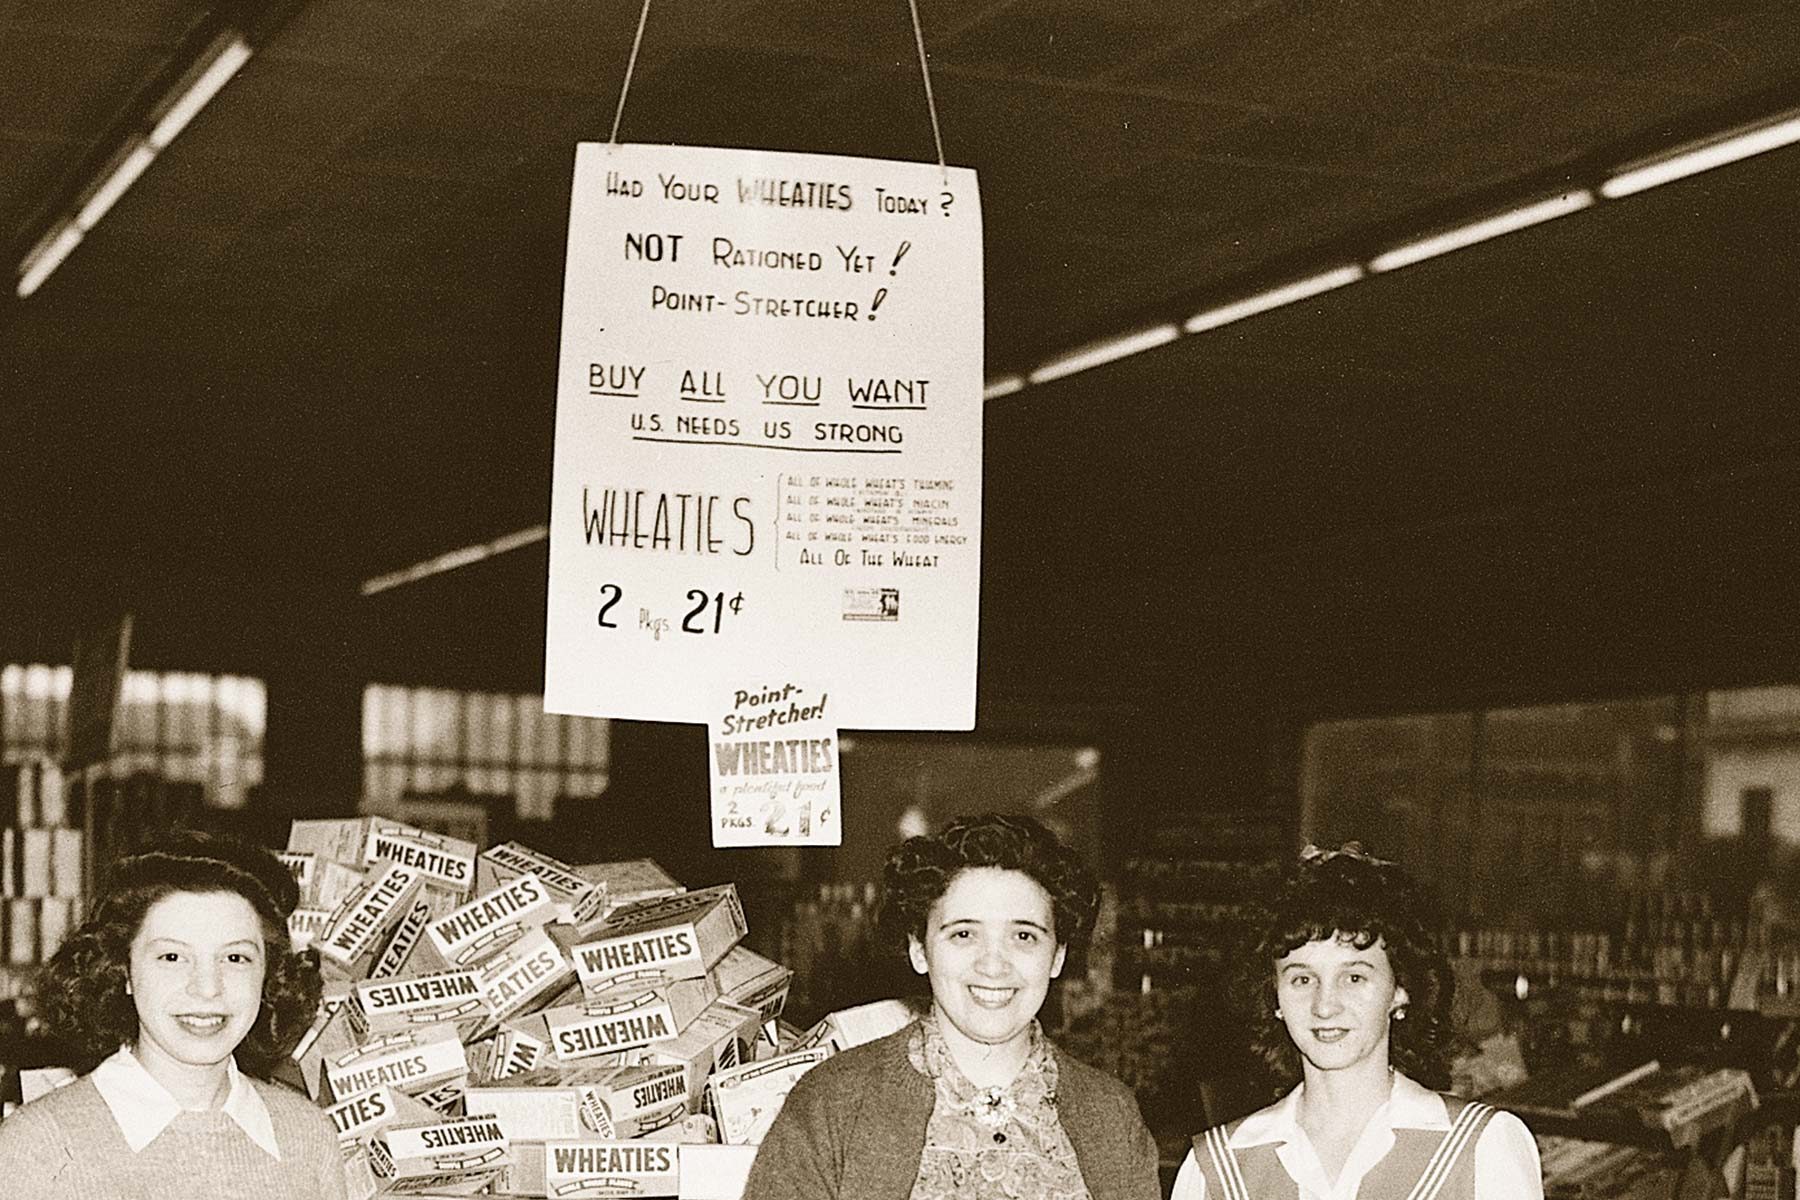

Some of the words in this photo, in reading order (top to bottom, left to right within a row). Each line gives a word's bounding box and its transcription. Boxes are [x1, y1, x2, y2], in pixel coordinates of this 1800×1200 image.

[737, 178, 854, 210] WHEATIES
[625, 232, 683, 263] NOT
[713, 237, 822, 272] RATIONED
[588, 363, 646, 390] BUY
[680, 369, 726, 397] ALL
[756, 373, 823, 401] YOU
[848, 377, 930, 405] WANT
[631, 412, 663, 431] U.S.
[676, 416, 740, 437] NEEDS
[764, 421, 791, 440] US
[815, 424, 903, 444] STRONG
[583, 488, 755, 556] WHEATIES
[800, 548, 823, 566] ALL
[835, 548, 852, 566] OF
[861, 549, 884, 567] THE
[892, 550, 940, 568] WHEAT
[598, 583, 623, 629] 2
[721, 693, 828, 736] Stretcher!
[734, 682, 804, 710] Point-
[714, 737, 834, 777] WHEATIES
[376, 839, 467, 880] WHEATIES
[493, 849, 585, 891] WHEATIES
[332, 869, 410, 951] WHEATIES
[436, 880, 539, 945] WHEATIES
[581, 932, 692, 973] WHEATIES
[369, 975, 479, 1008] WHEATIES
[559, 1014, 669, 1054] WHEATIES
[333, 1056, 428, 1096] WHEATIES
[633, 1075, 687, 1109] WHEATIES
[586, 1090, 613, 1139] WHEATIES
[421, 1123, 505, 1149] WHEATIES
[554, 1147, 671, 1173] WHEATIES
